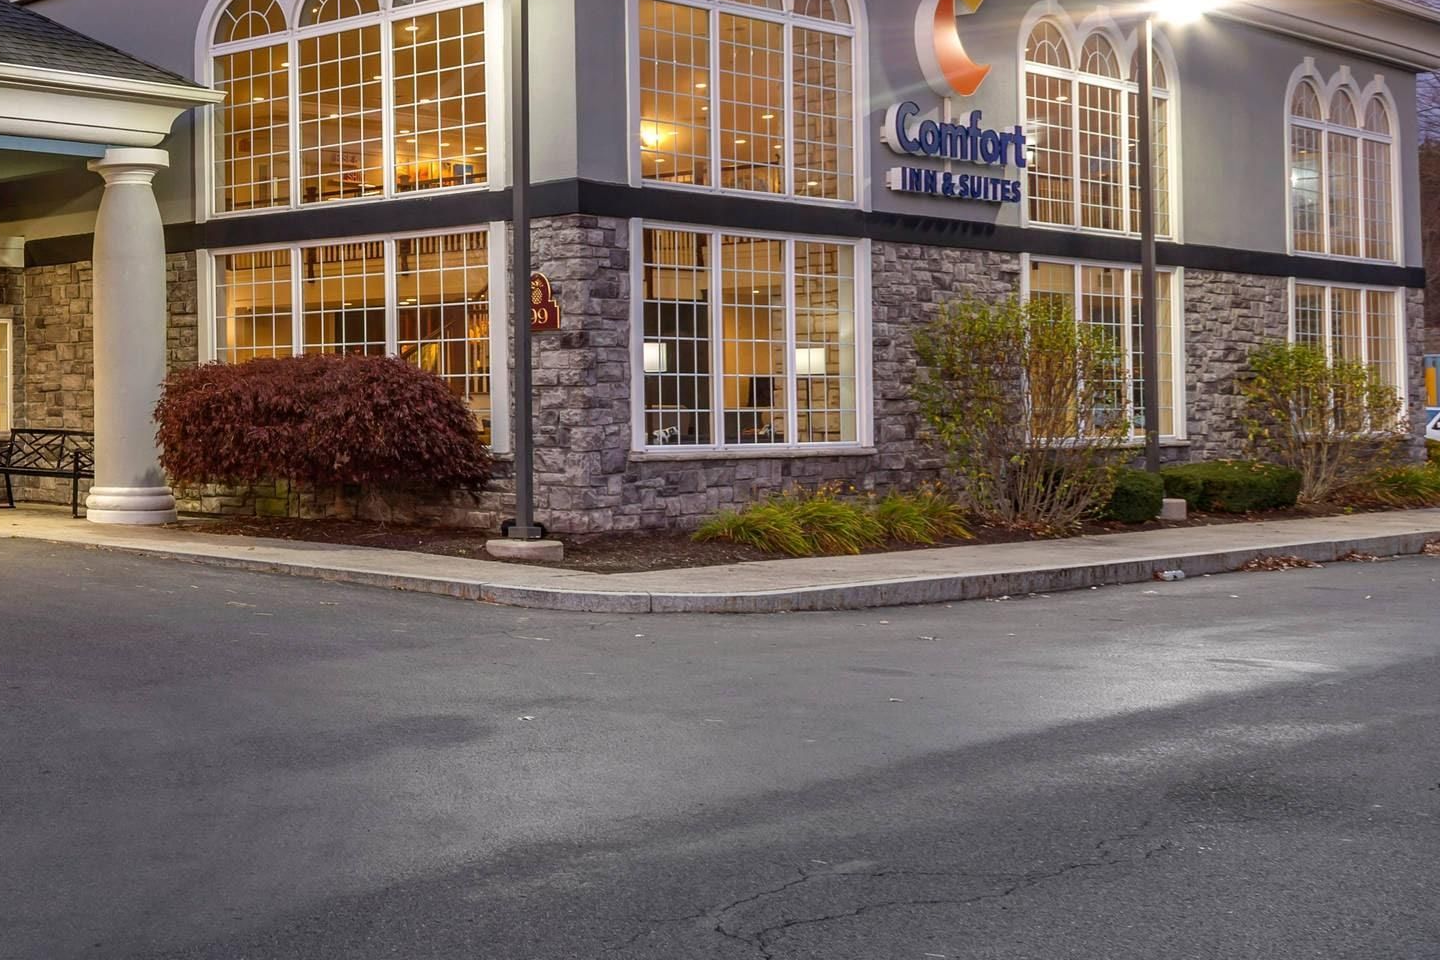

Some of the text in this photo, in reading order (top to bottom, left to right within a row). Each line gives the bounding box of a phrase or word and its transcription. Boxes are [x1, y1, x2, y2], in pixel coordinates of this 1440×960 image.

[895, 101, 1027, 168] Comfort
[901, 166, 1022, 203] INN & SUITES
